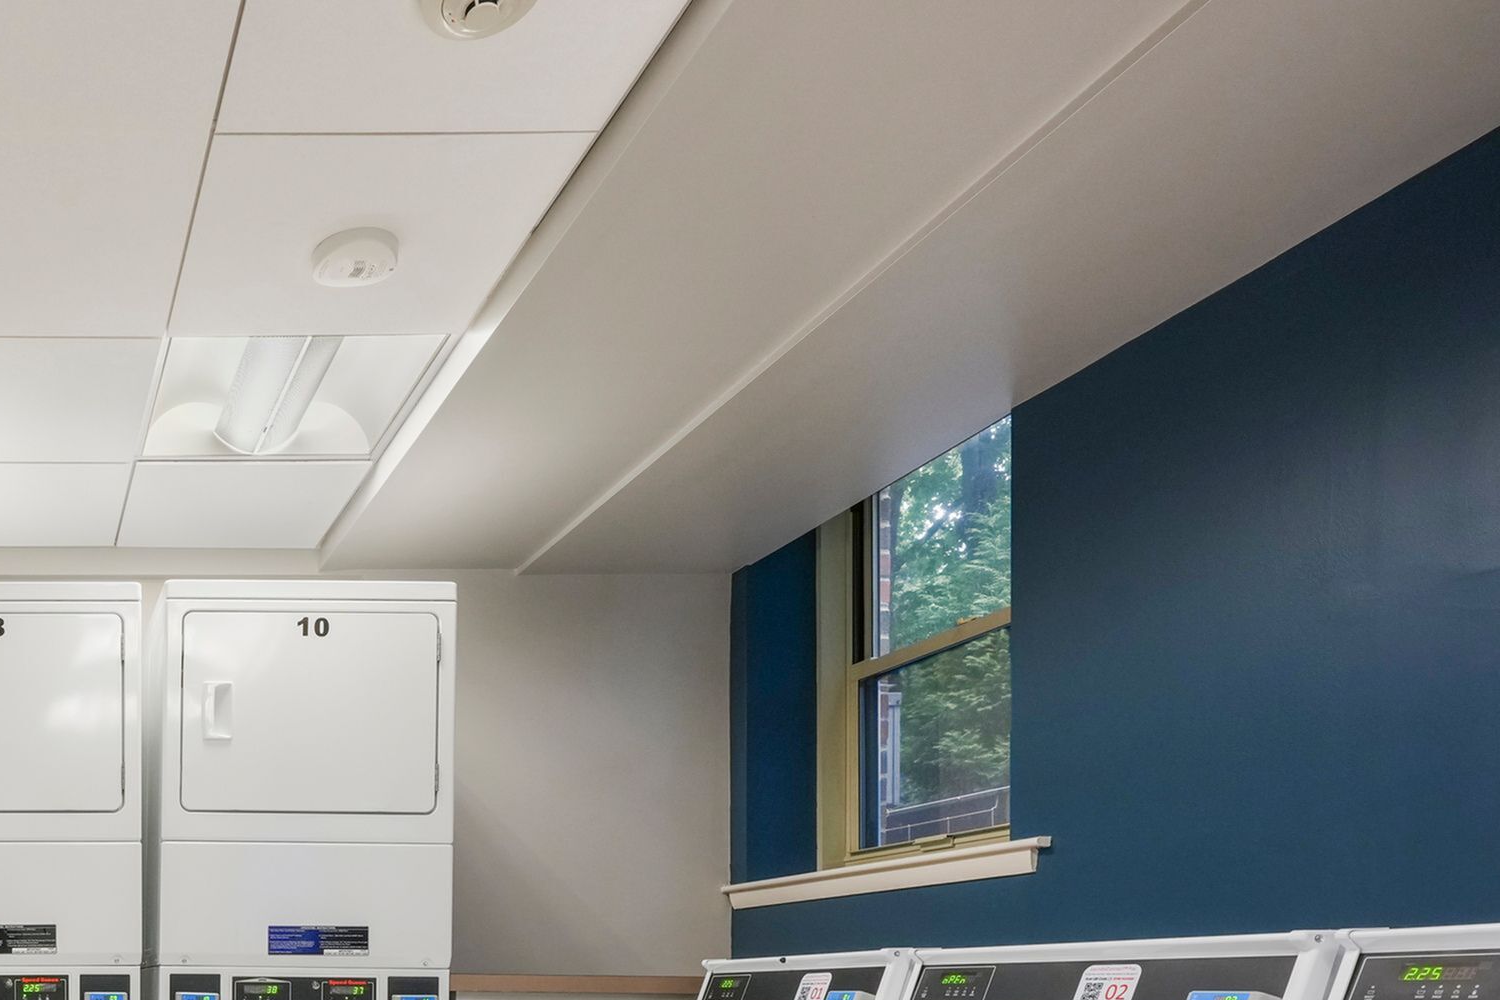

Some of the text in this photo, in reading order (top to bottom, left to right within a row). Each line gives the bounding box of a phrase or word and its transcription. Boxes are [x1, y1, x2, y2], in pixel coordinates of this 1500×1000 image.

[297, 616, 330, 637] 10
[810, 987, 823, 999] 01
[1105, 984, 1128, 1000] 02
